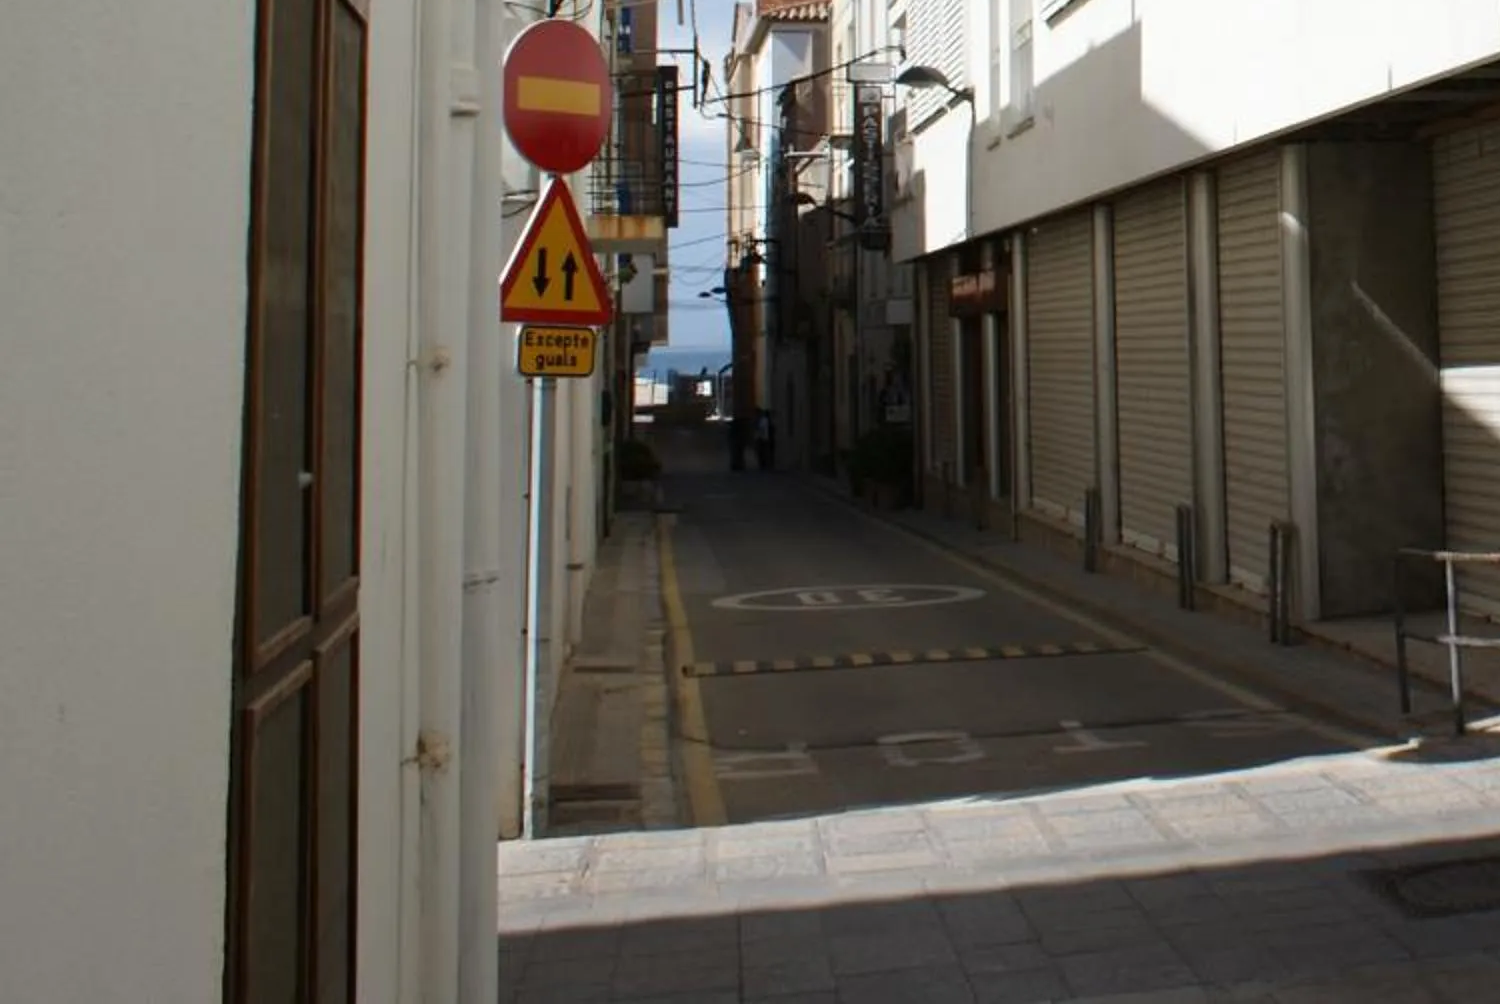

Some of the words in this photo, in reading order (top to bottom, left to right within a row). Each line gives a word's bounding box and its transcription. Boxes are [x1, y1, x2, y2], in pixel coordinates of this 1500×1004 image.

[663, 79, 676, 215] RESTAURANT
[525, 331, 589, 349] Excepte
[536, 353, 577, 370] guals
[795, 589, 905, 606] 30
